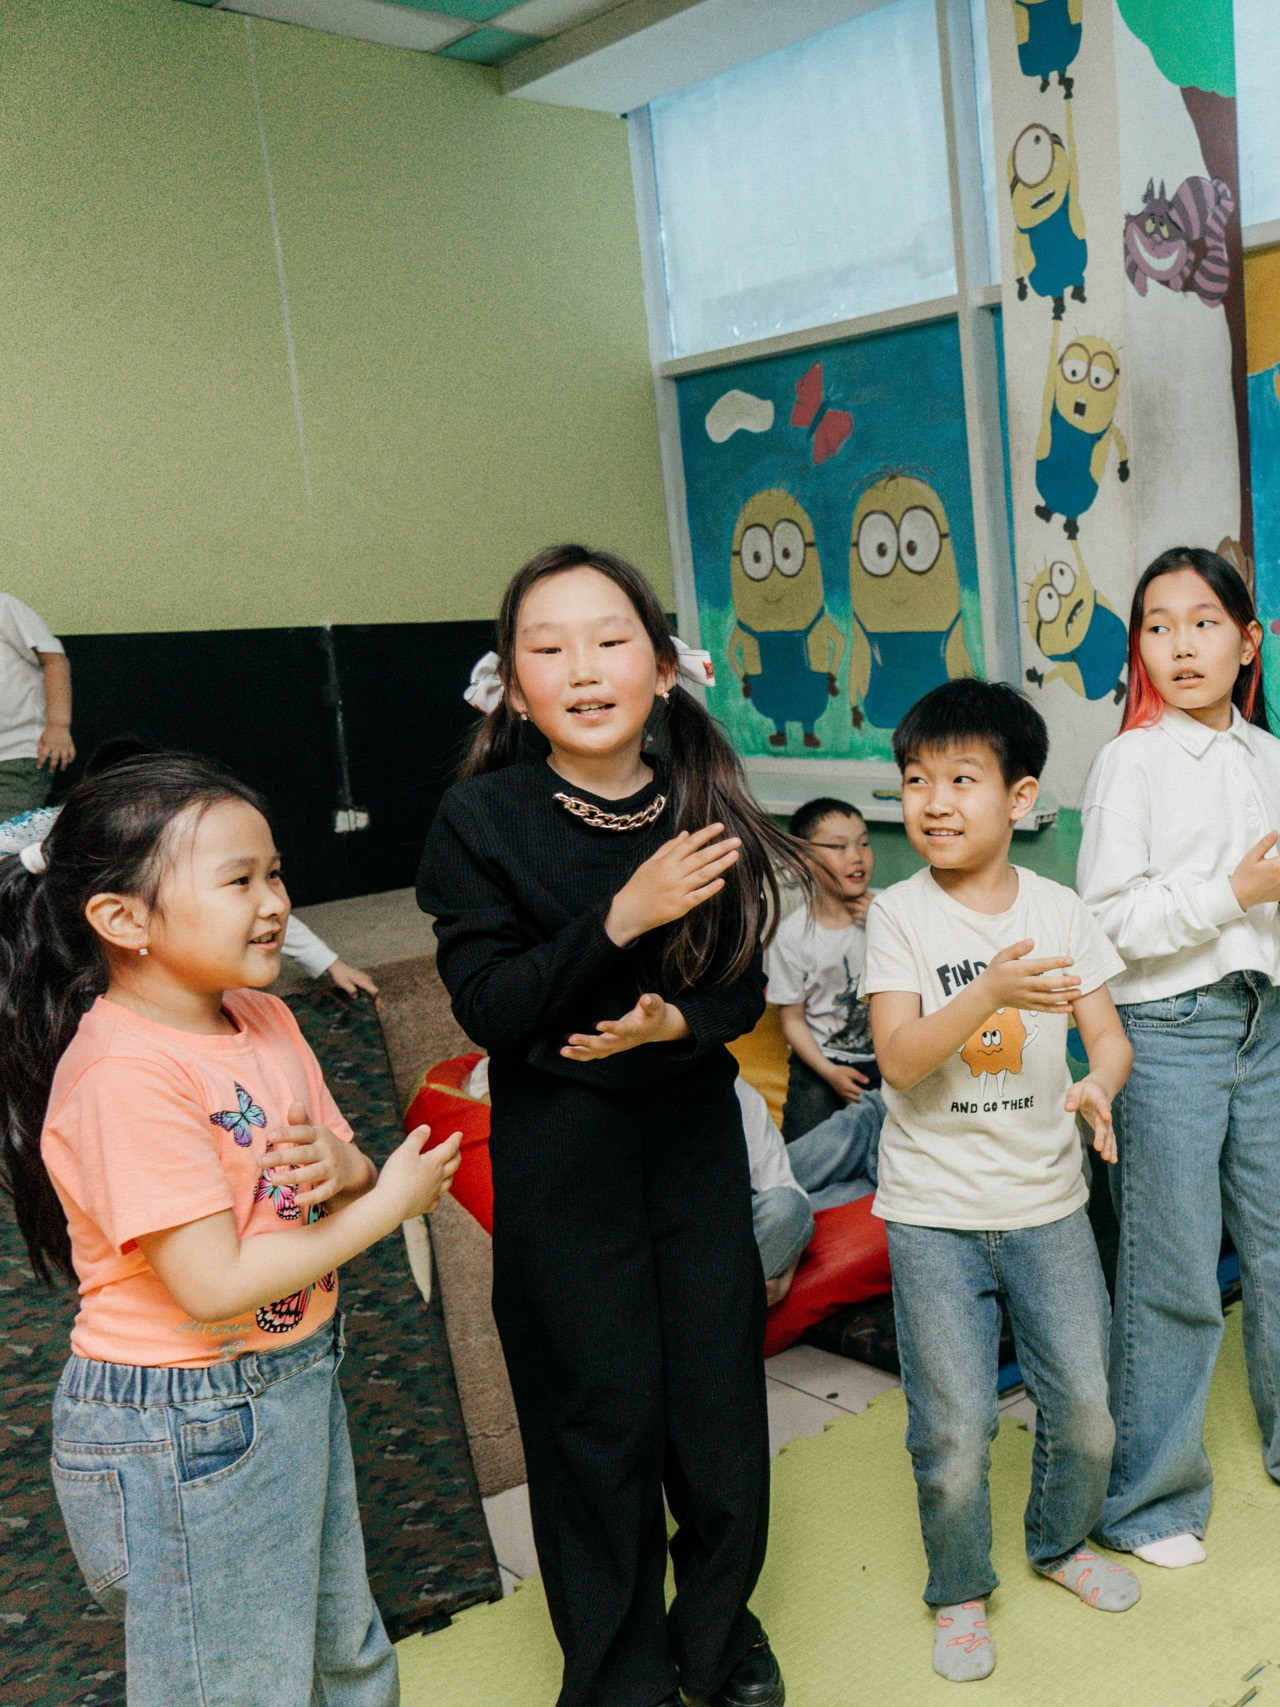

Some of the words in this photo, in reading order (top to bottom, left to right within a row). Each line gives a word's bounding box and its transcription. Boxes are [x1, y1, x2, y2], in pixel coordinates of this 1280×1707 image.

[950, 1101, 978, 1114] AND
[983, 1101, 998, 1112] GO
[1002, 1095, 1034, 1111] THERE
